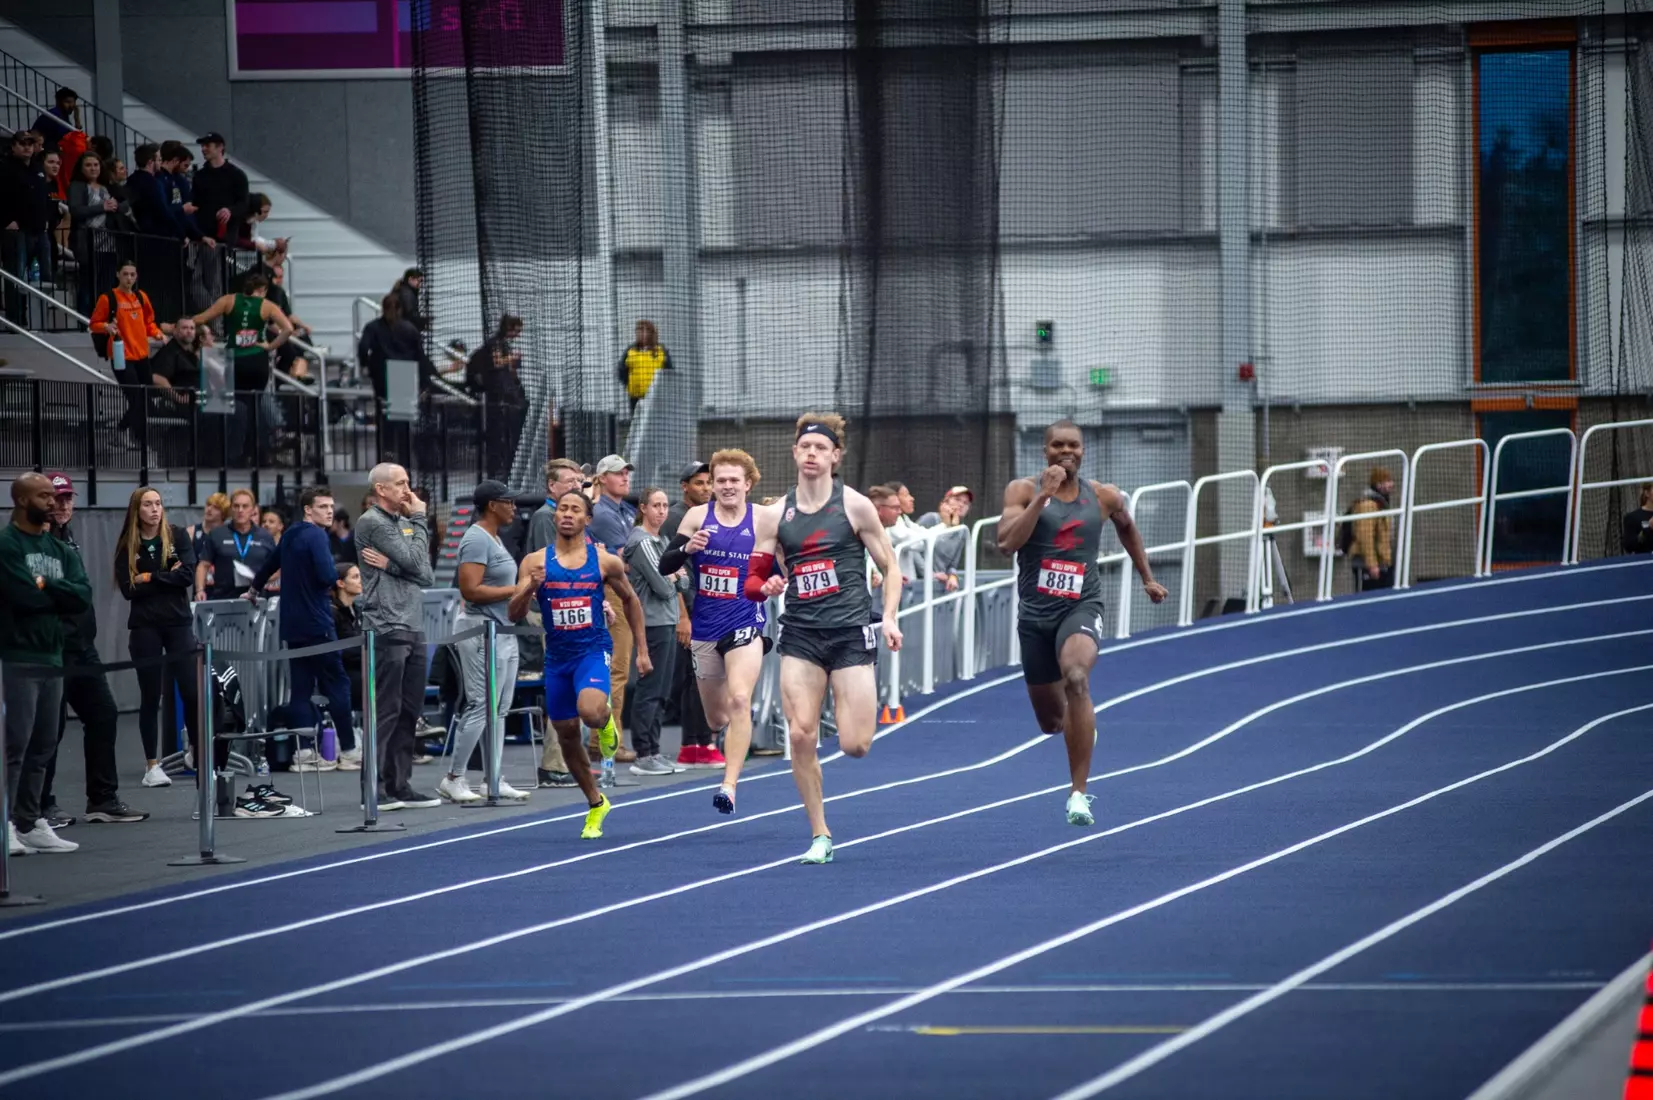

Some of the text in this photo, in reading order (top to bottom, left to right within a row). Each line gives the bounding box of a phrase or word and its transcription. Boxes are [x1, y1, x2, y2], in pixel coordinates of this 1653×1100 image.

[703, 549, 726, 558] WEBER
[812, 562, 826, 570] OPEN
[1051, 562, 1077, 572] WSU OPEN
[705, 576, 730, 592] 911
[802, 571, 831, 591] 879
[1046, 571, 1074, 591] 881
[559, 609, 585, 624] 166
